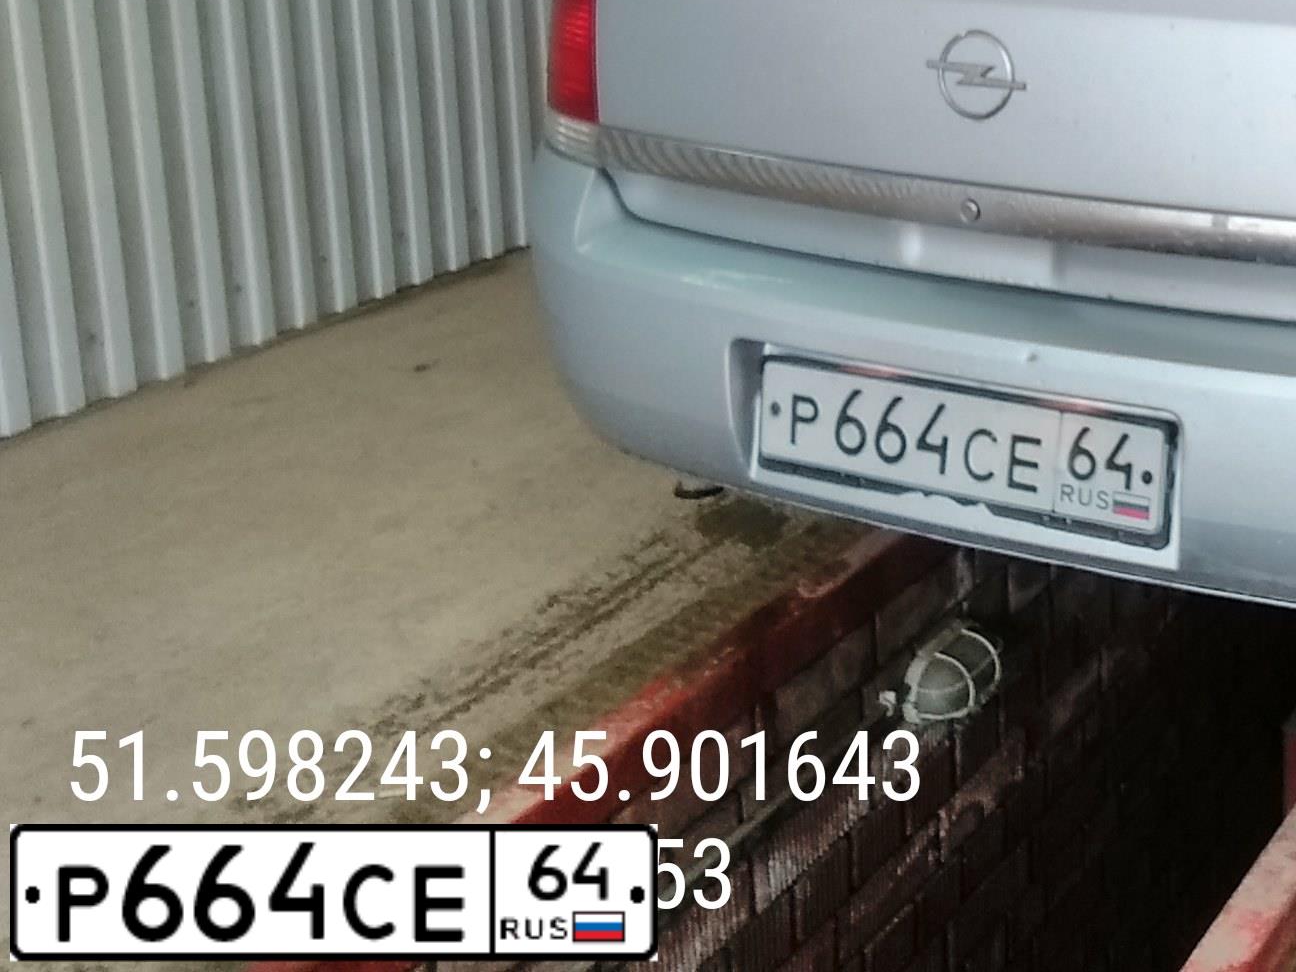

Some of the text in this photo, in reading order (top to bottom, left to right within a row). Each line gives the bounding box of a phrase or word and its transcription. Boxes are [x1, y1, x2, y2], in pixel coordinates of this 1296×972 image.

[788, 388, 1133, 494] P664CE 64
[1060, 483, 1110, 510] RUS
